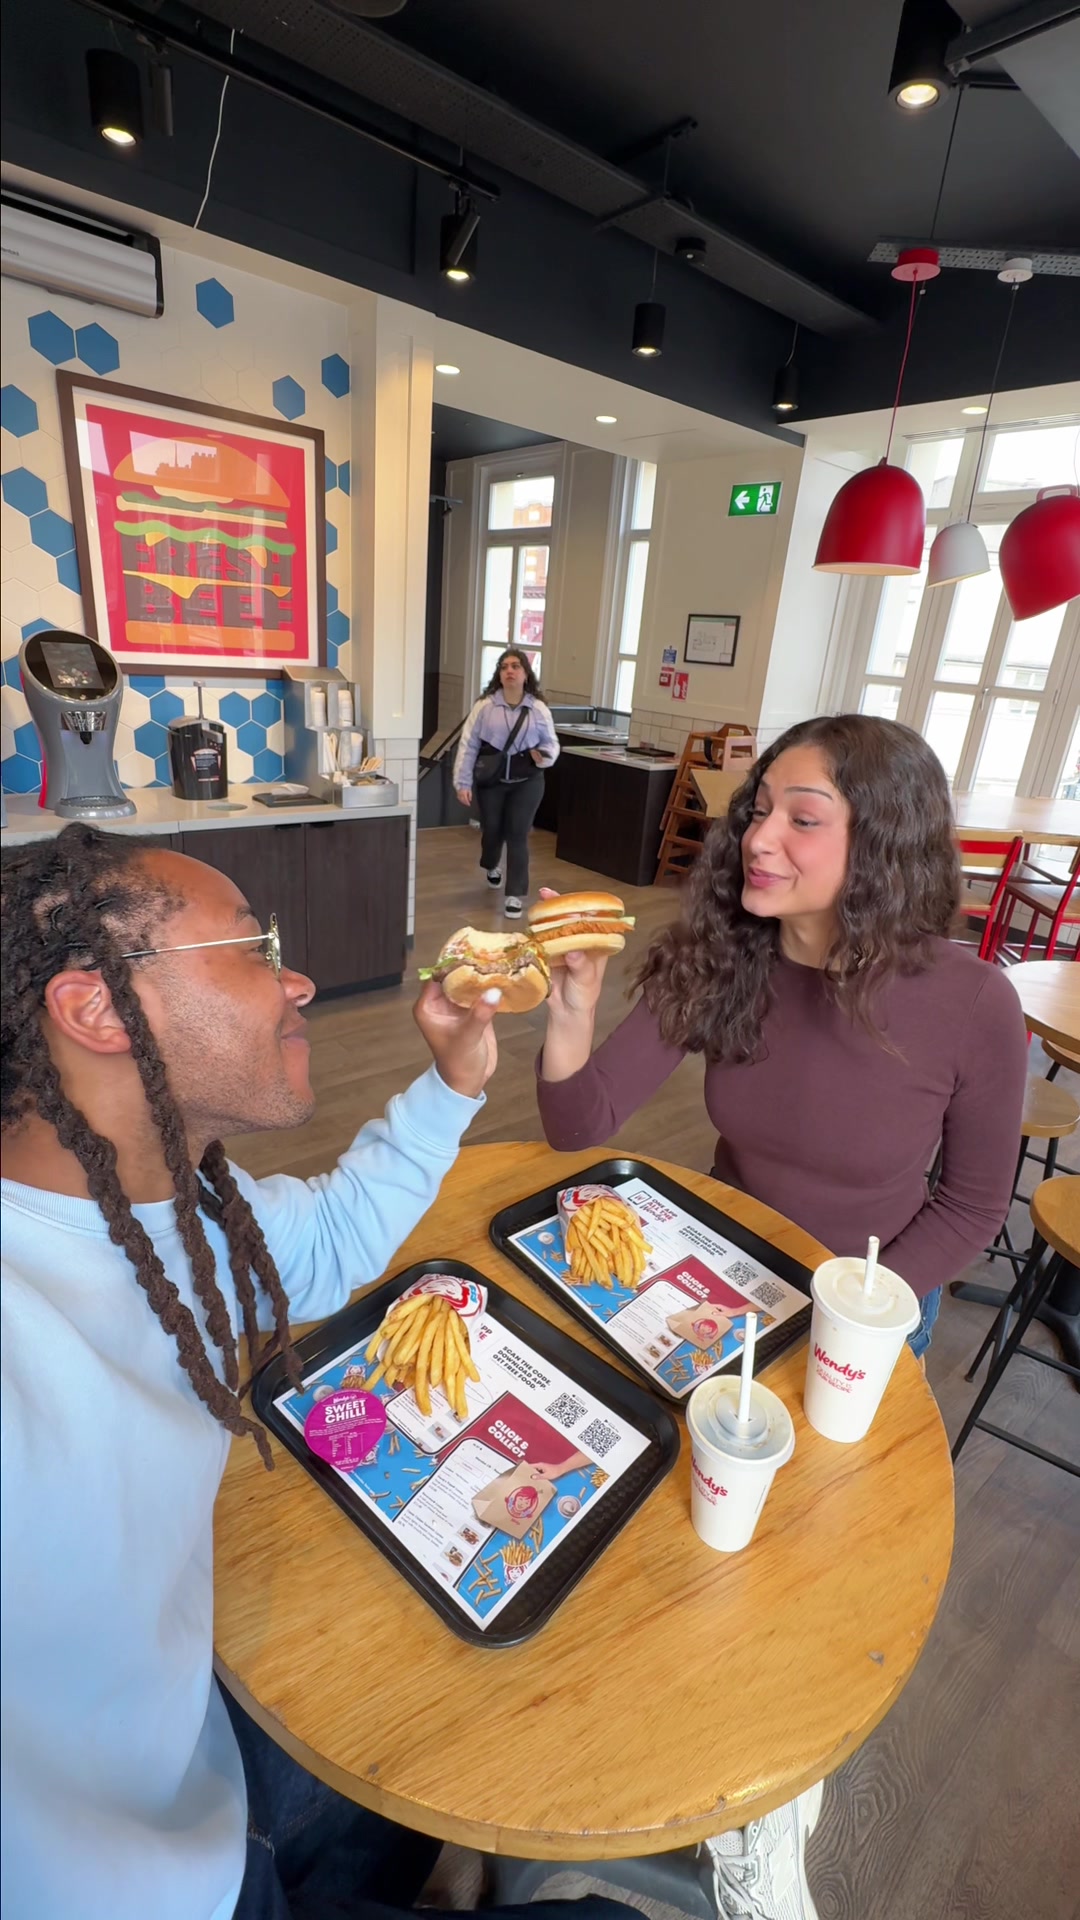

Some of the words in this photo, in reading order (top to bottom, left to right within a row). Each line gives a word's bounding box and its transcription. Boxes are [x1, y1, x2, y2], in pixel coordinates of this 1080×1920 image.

[120, 534, 292, 586] FRESH
[124, 575, 292, 630] BEEF
[647, 1202, 660, 1211] ALL
[660, 1210, 673, 1220] THE
[652, 1199, 665, 1208] ONE
[664, 1208, 678, 1218] APP
[682, 1228, 712, 1248] DOWNLOAD
[686, 1226, 702, 1236] SCAN
[688, 1236, 700, 1246] FREE
[676, 1275, 708, 1298] COLLECT
[682, 1271, 705, 1290] CLICK
[481, 1323, 493, 1335] PP
[492, 1354, 505, 1364] GET
[503, 1362, 519, 1376] FREE
[518, 1374, 536, 1390] FOOD.
[497, 1350, 532, 1378] DOWNLOAD
[532, 1378, 546, 1390] APP.
[502, 1346, 521, 1361] SCAN
[520, 1360, 533, 1370] THE
[532, 1369, 552, 1386] CODE.
[814, 1342, 866, 1381] Wendy's
[325, 1400, 366, 1416] SWEET
[325, 1407, 366, 1424] CHILLI
[488, 1426, 526, 1459] COLLECT
[494, 1420, 522, 1442] CLICK
[518, 1442, 529, 1450] &
